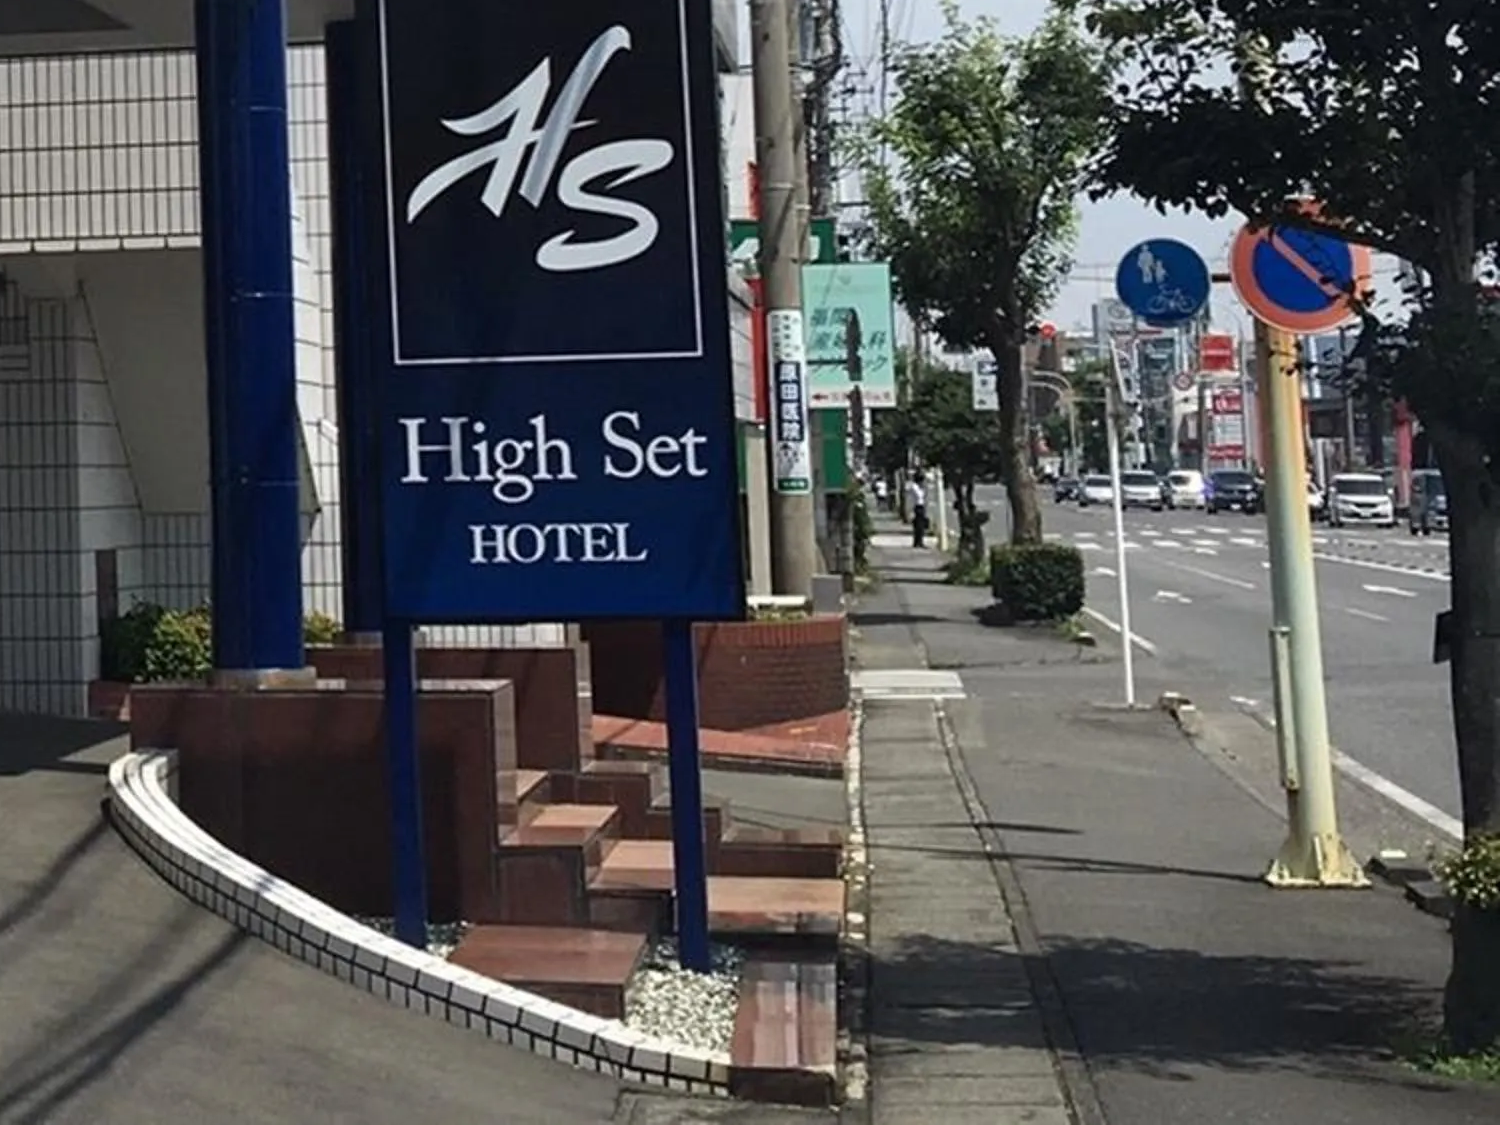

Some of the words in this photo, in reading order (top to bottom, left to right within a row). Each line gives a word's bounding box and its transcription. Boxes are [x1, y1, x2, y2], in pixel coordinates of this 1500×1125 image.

[398, 414, 578, 503] High
[602, 411, 708, 478] Set
[467, 523, 648, 563] HOTEL
